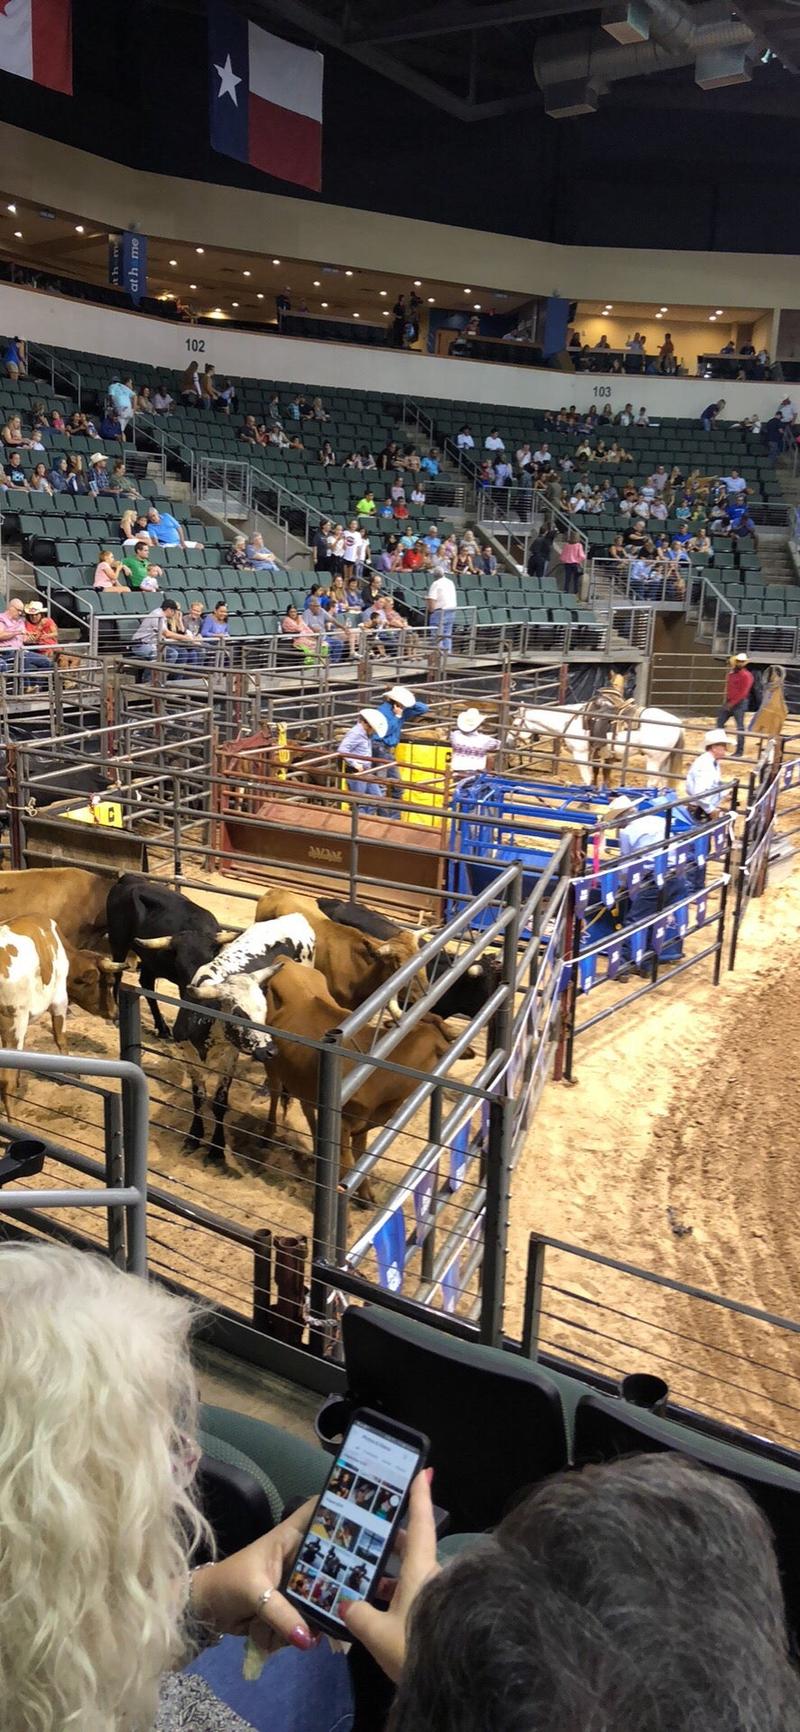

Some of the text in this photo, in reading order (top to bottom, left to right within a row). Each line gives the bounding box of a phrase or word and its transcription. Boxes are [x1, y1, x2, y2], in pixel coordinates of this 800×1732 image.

[129, 279, 138, 292] at
[185, 338, 205, 352] 102
[593, 386, 612, 398] 103
